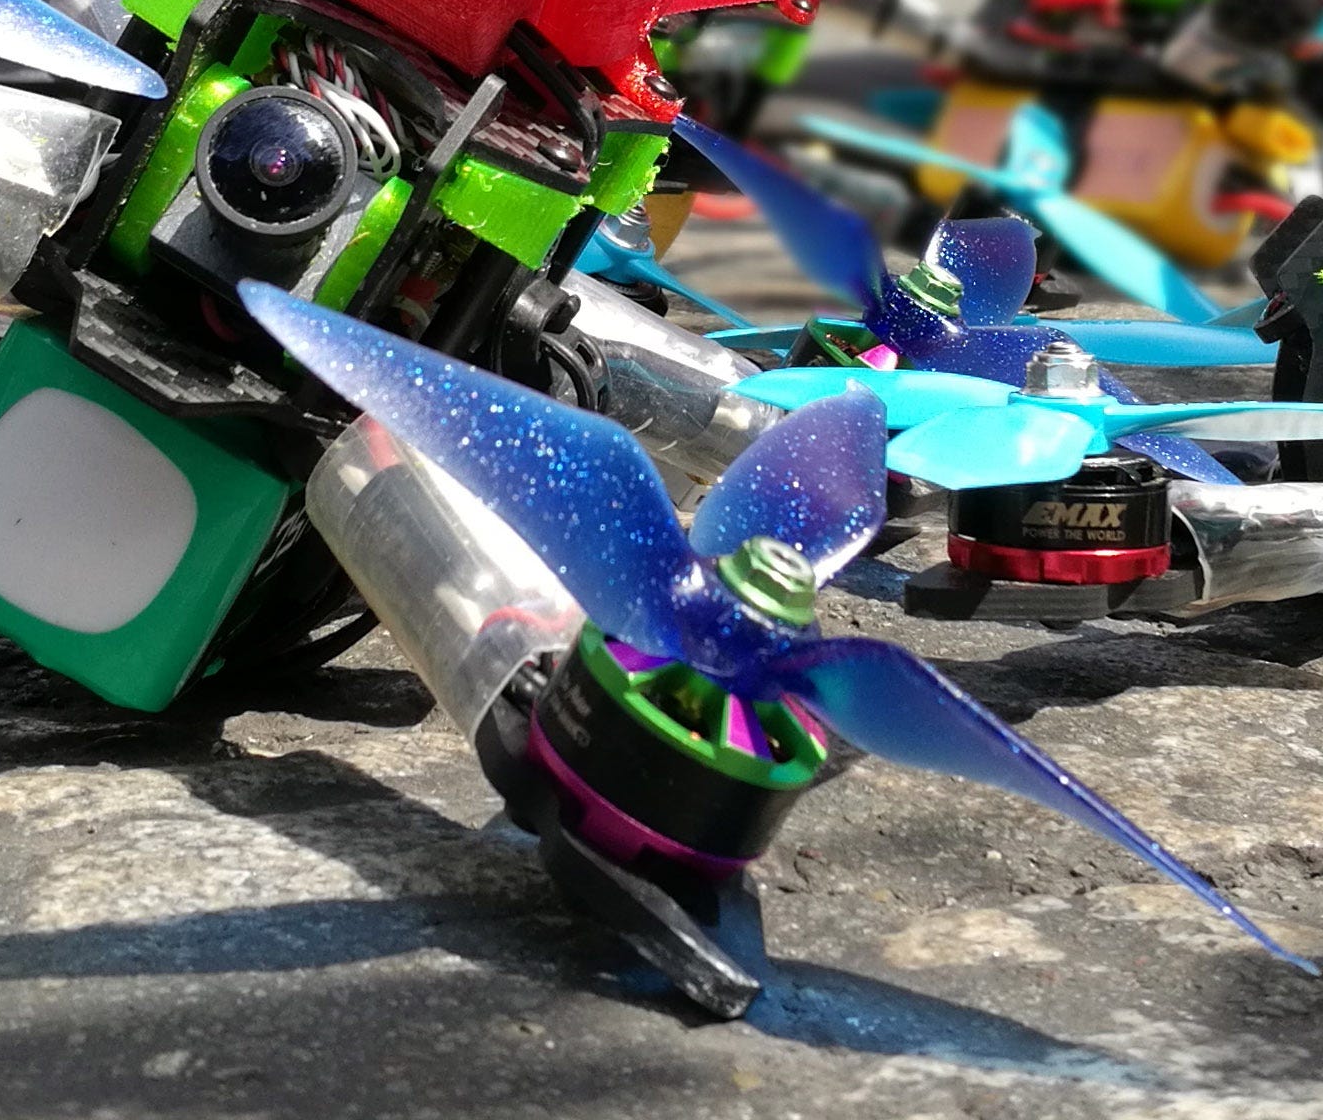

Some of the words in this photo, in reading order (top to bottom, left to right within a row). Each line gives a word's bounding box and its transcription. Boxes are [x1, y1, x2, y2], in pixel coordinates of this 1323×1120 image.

[1021, 501, 1128, 528] EMAX
[1064, 529, 1083, 541] THE
[1086, 529, 1127, 542] WORLD
